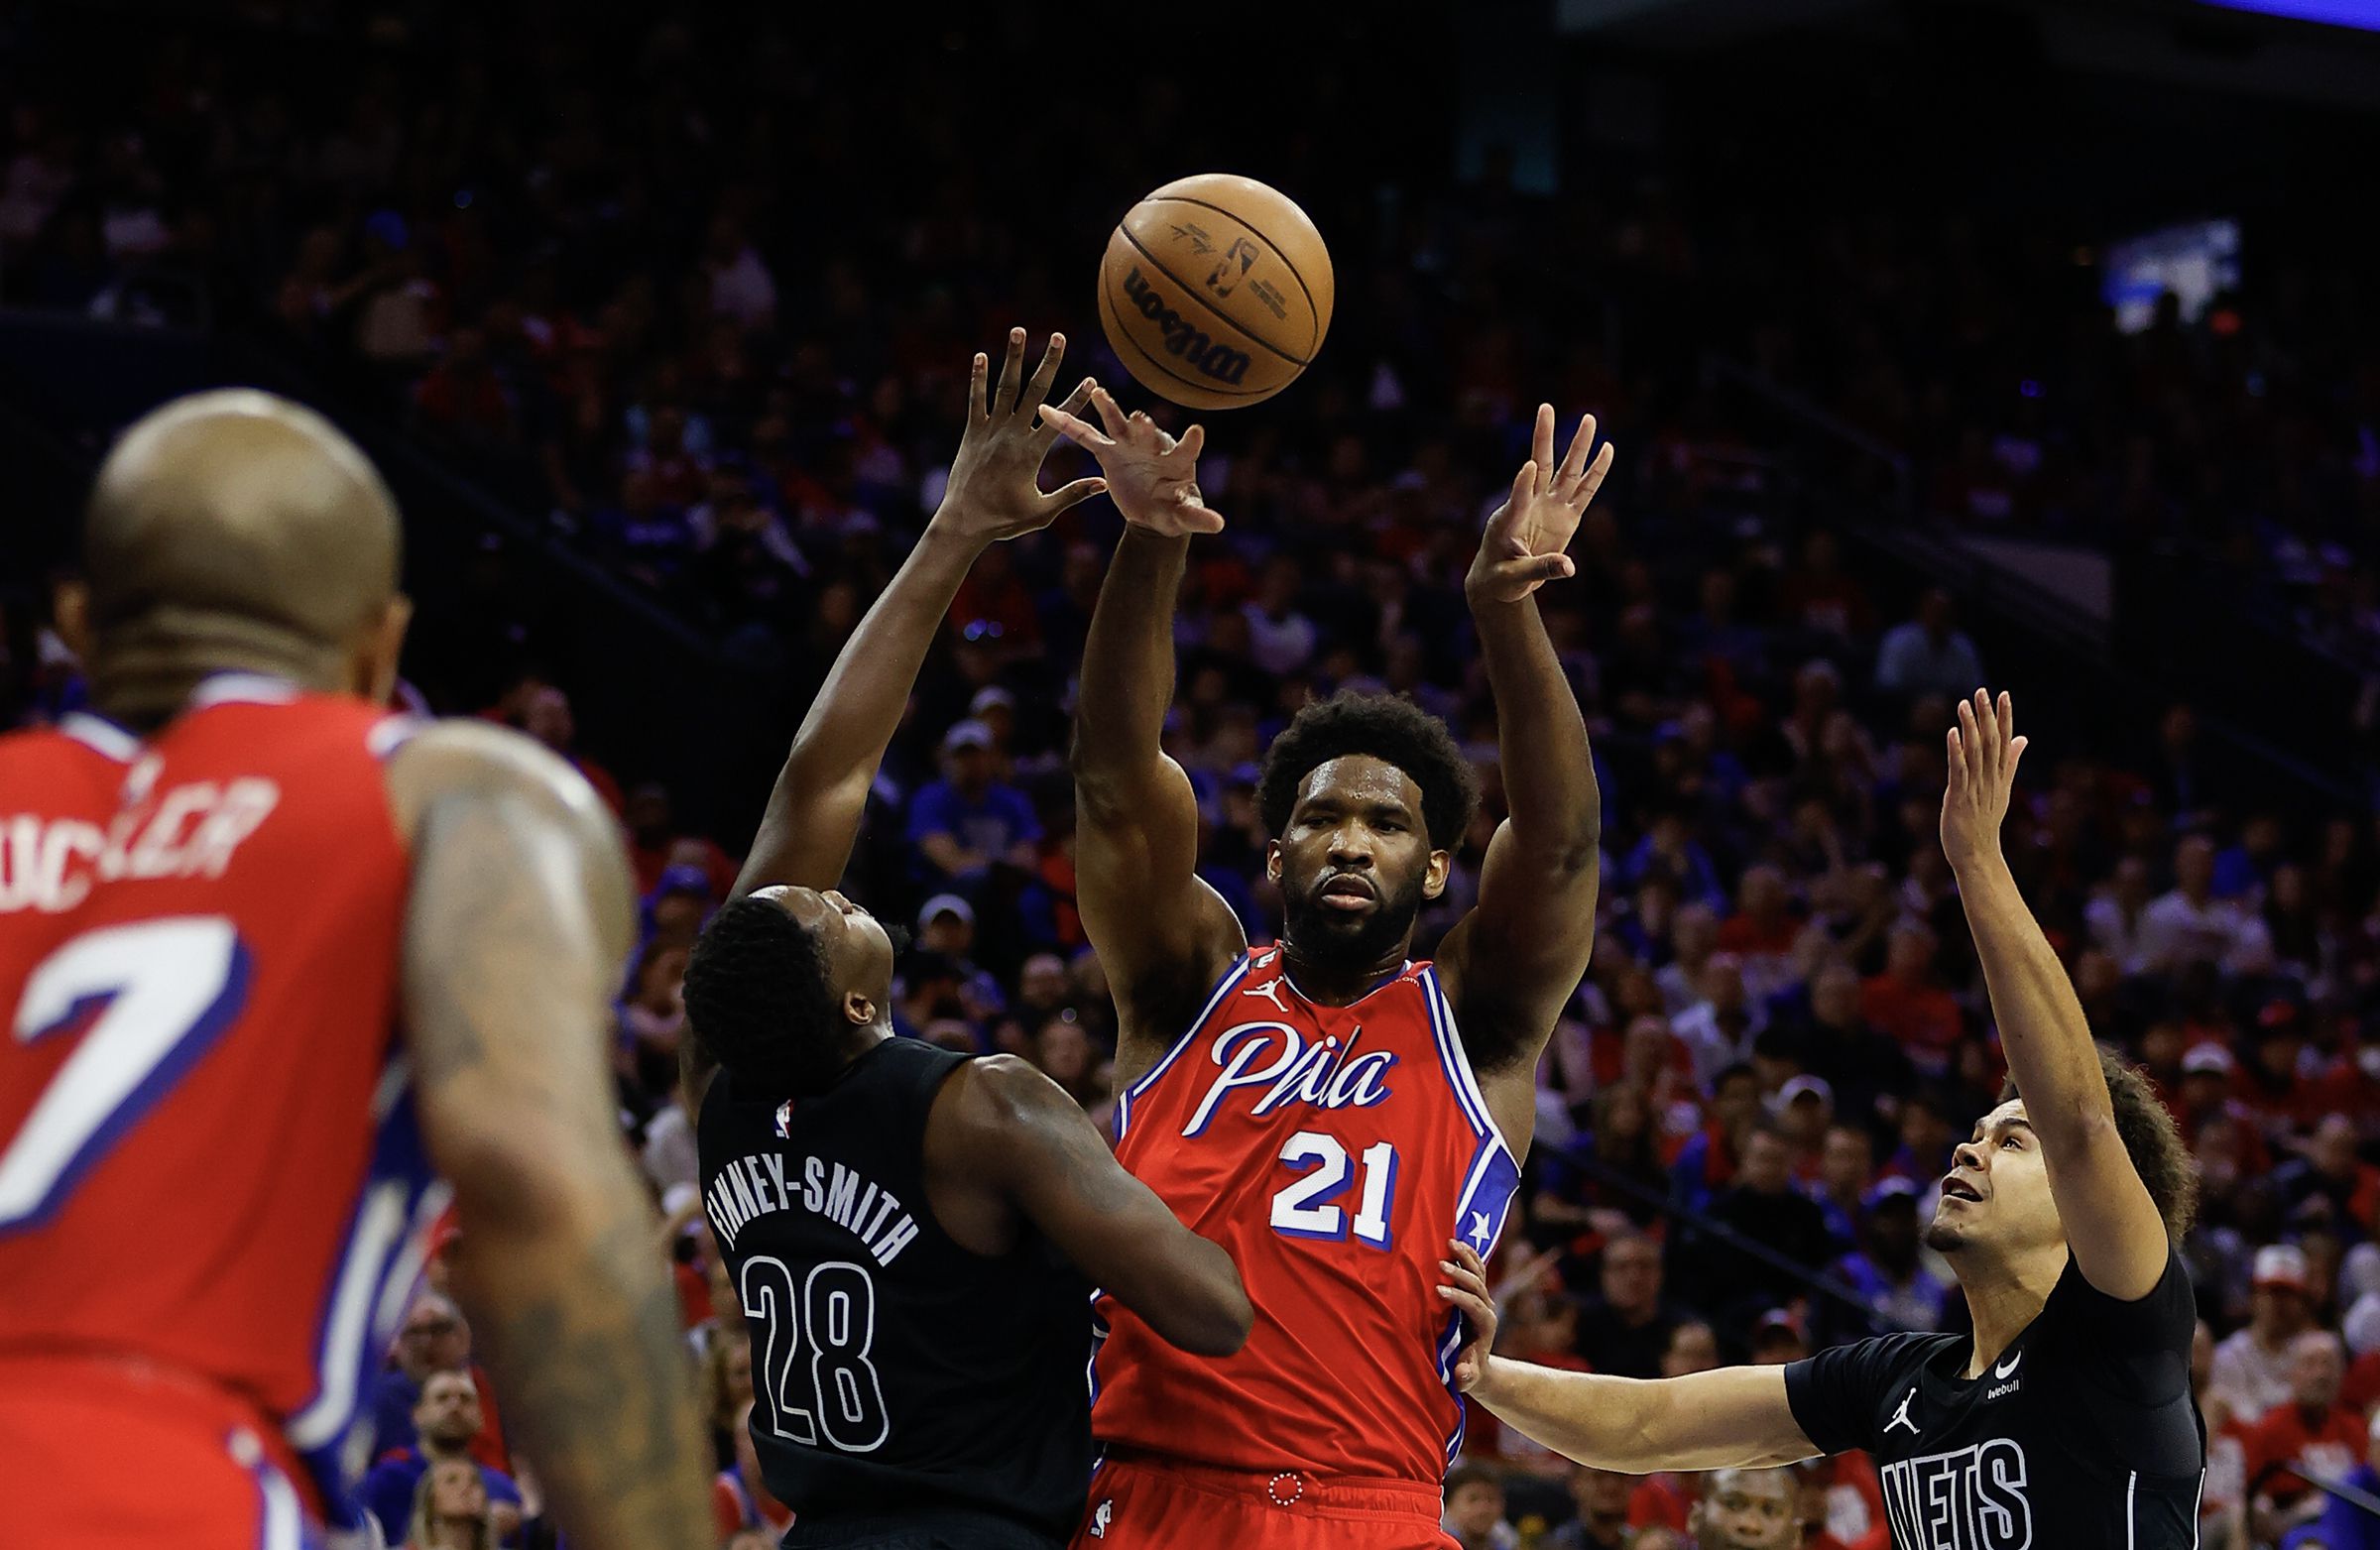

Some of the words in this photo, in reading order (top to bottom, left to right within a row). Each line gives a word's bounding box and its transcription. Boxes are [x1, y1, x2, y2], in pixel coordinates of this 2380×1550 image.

[0, 913, 252, 1236] 7
[707, 1152, 919, 1267] FINNEY-SMITH
[1269, 1131, 1399, 1250] 21
[742, 1254, 890, 1452] 28
[1881, 1438, 2033, 1550] NETS
